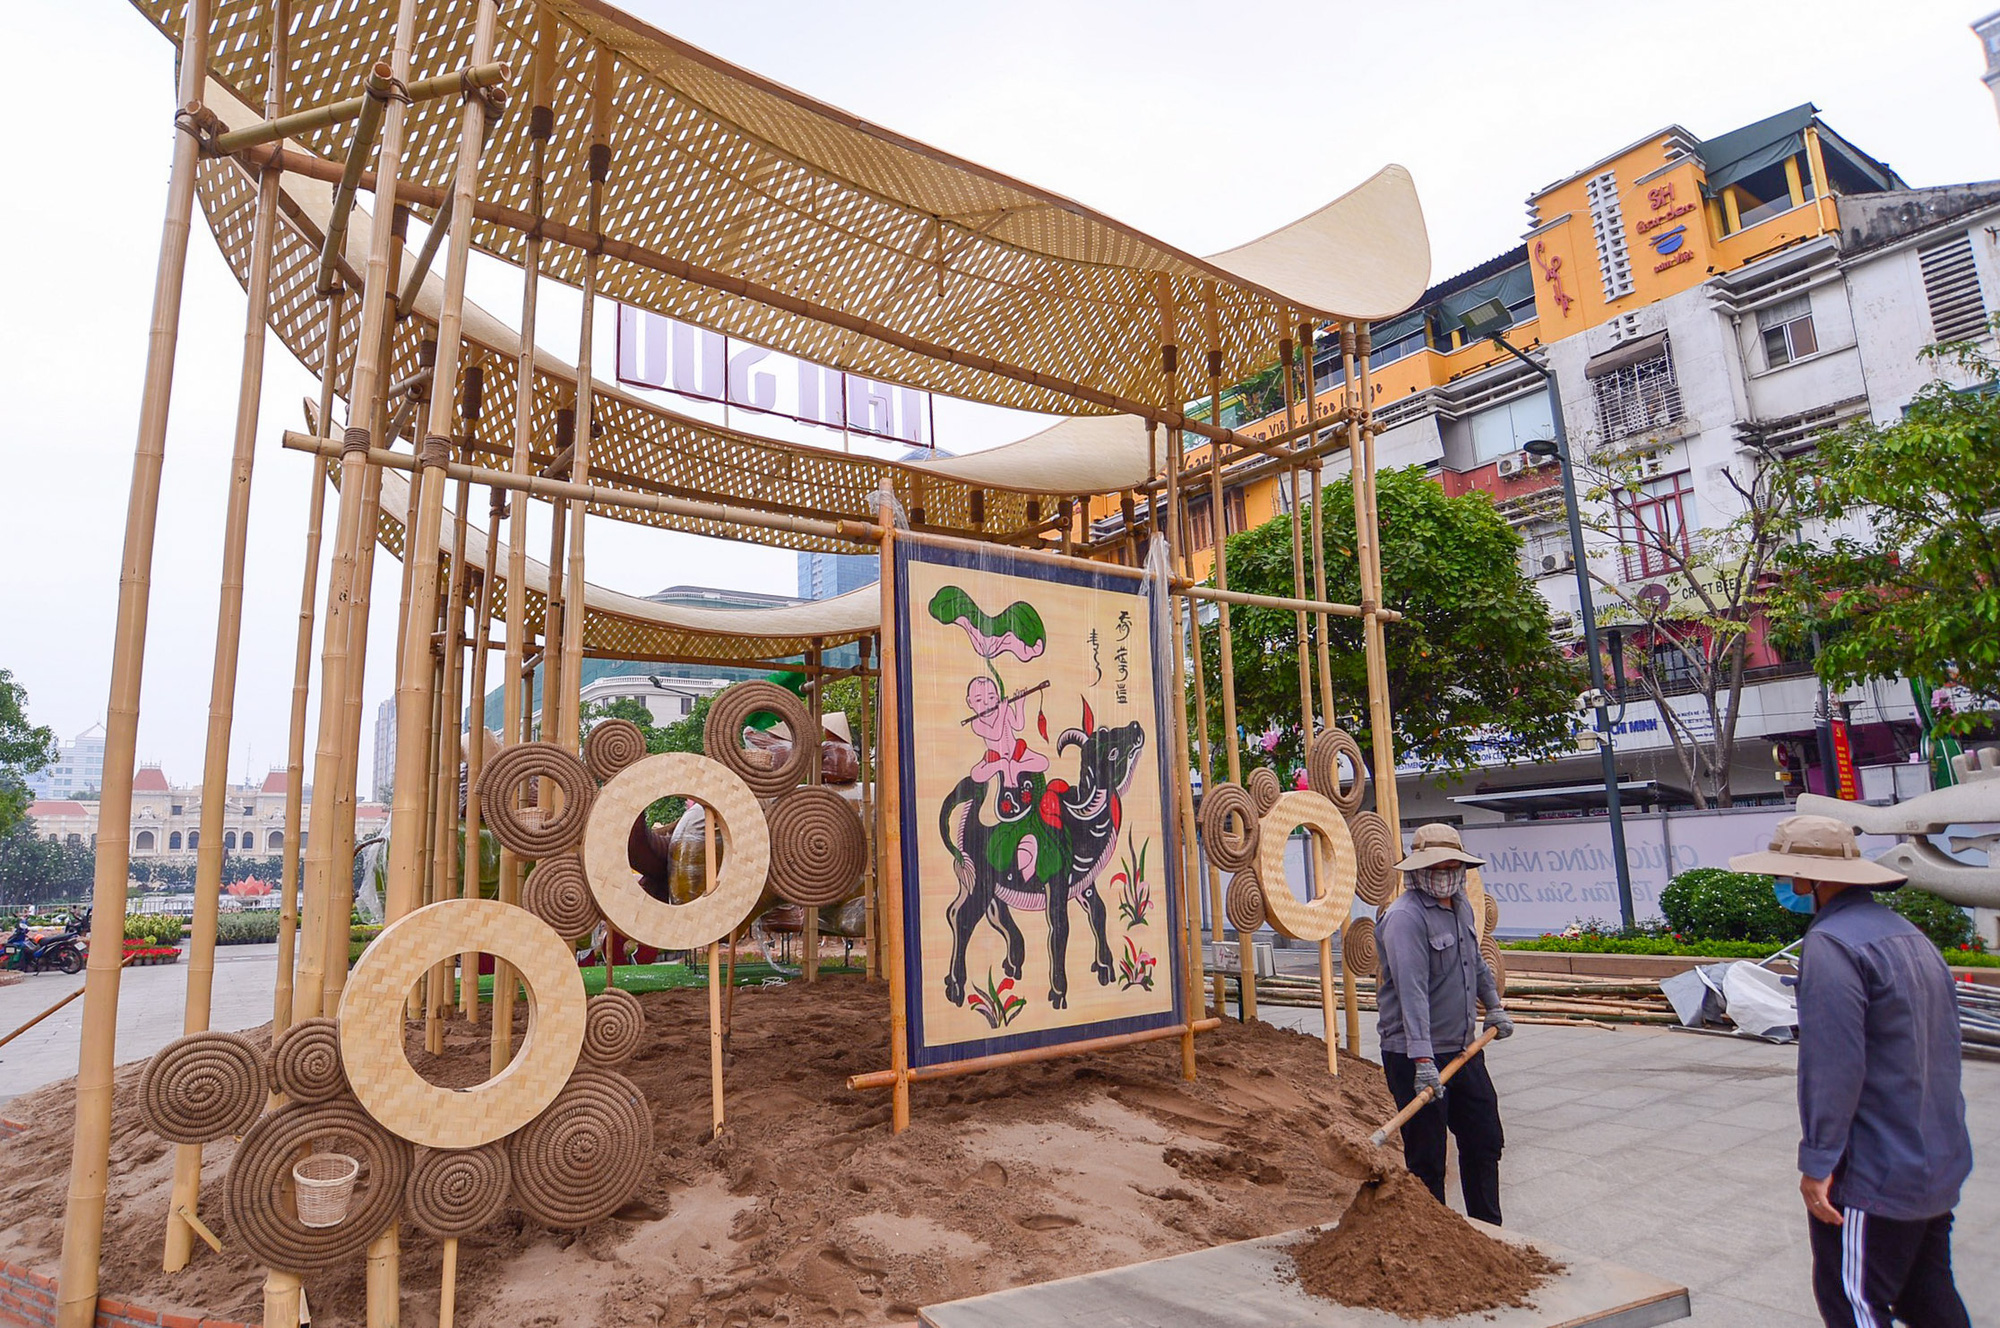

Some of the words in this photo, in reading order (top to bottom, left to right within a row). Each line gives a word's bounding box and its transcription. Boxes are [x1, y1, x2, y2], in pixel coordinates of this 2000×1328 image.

[1647, 182, 1675, 211] SH
[1635, 203, 1697, 235] Garden
[1682, 582, 1713, 600] CRFT
[1629, 718, 1658, 734] MINH
